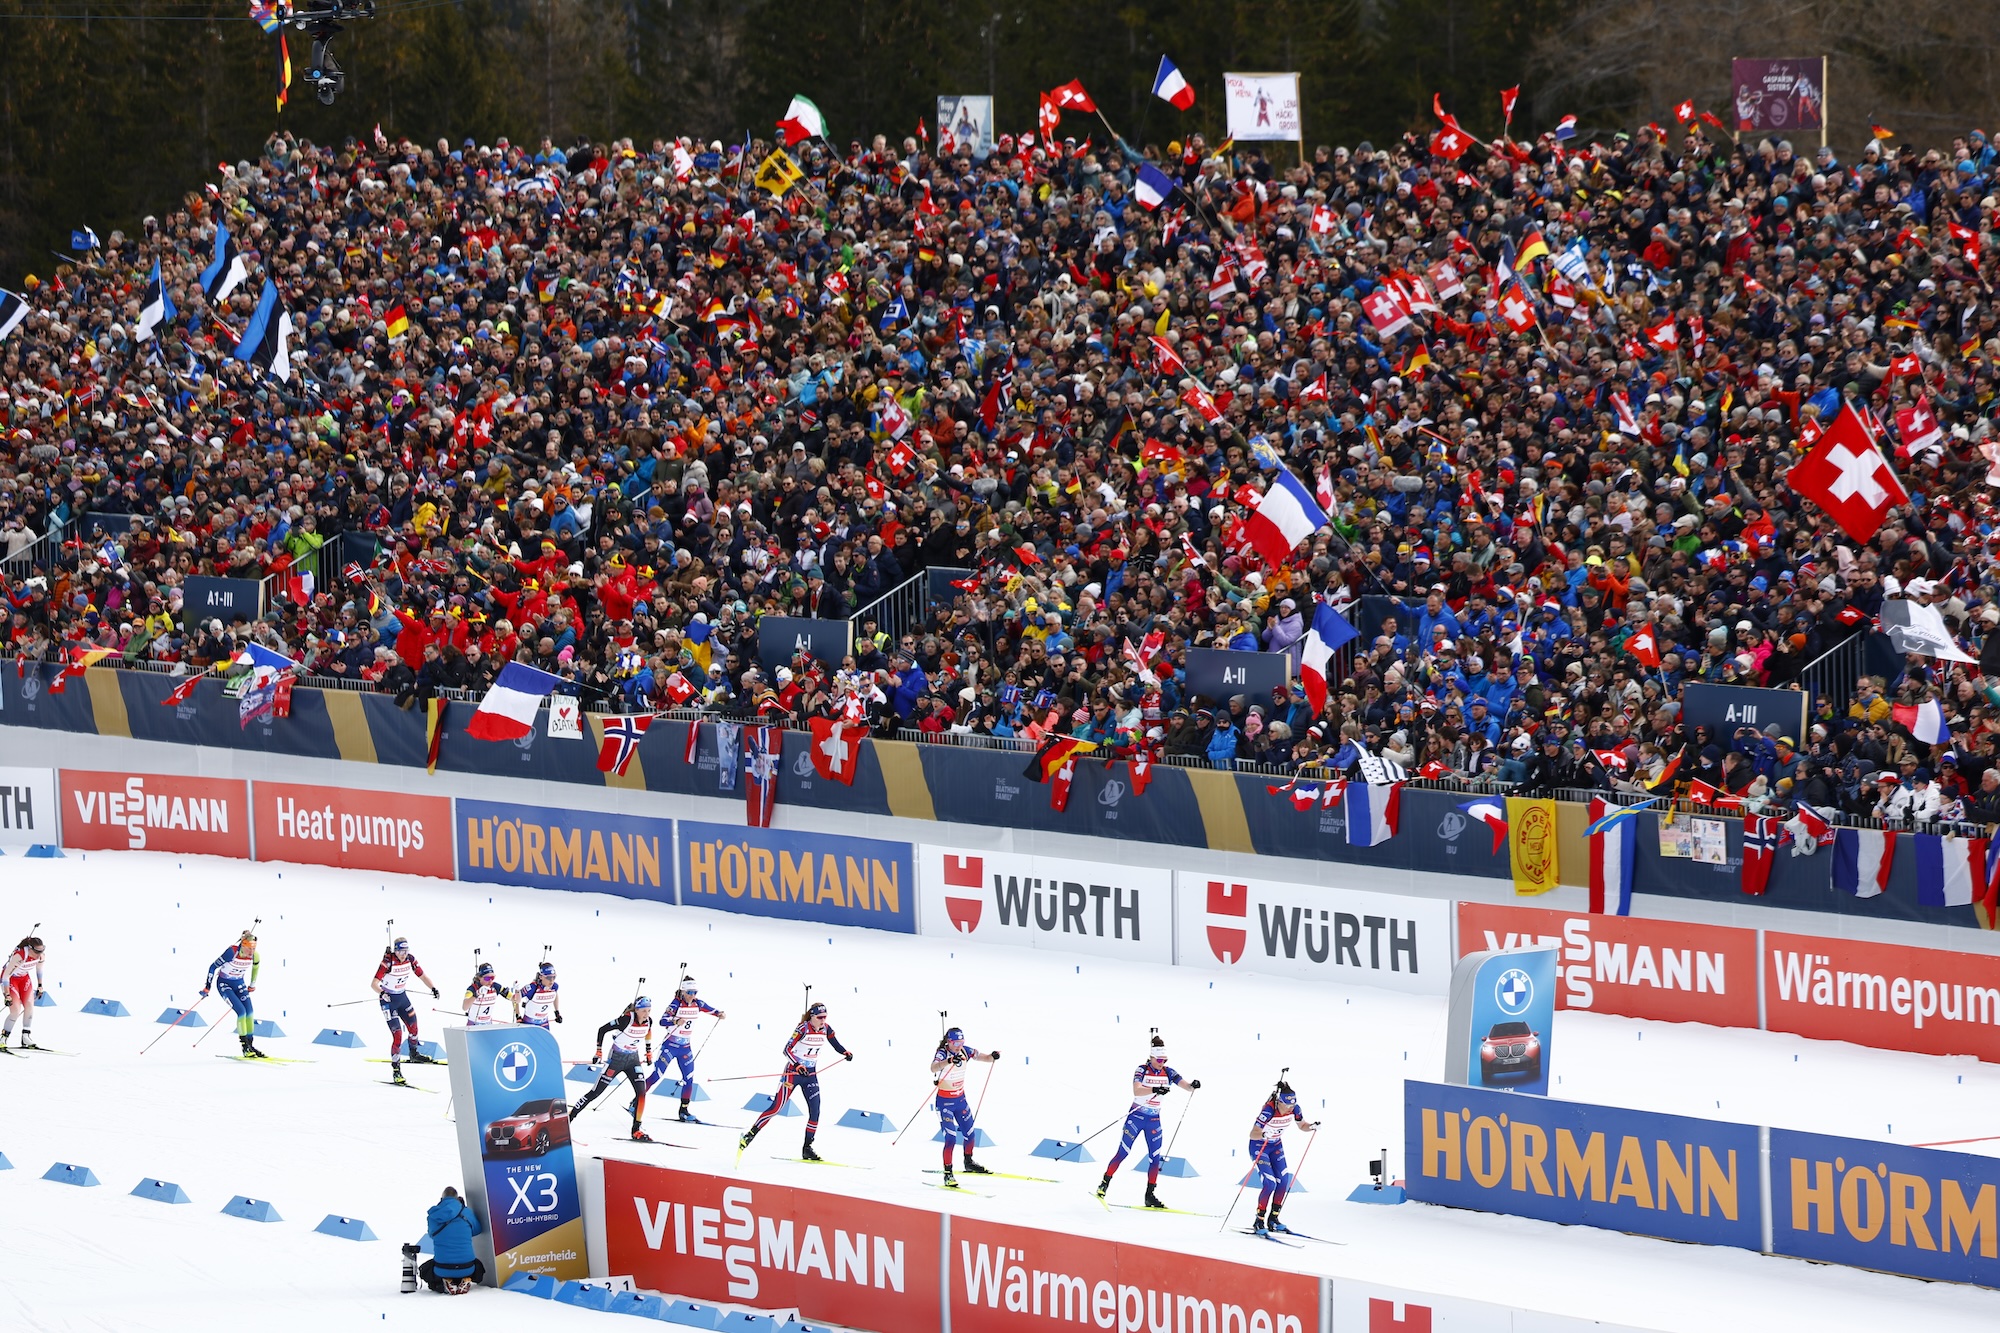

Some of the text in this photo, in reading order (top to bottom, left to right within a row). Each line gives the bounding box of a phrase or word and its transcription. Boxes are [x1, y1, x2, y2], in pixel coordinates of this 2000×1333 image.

[1763, 76, 1794, 84] GASPARIN
[206, 590, 234, 607] A1-III
[795, 633, 812, 650] A-I
[1223, 666, 1246, 685] A-II
[1725, 704, 1757, 724] A-III
[521, 753, 531, 761] IBU
[698, 755, 720, 763] BIATHLO
[698, 763, 717, 771] FAMILY
[801, 780, 812, 789] IBU
[995, 785, 1020, 794] BIATHLON
[995, 793, 1013, 801] FAMILY
[74, 777, 228, 849] VIESSMANN
[1105, 810, 1118, 820] IBU
[1320, 817, 1345, 826] BIATHLO
[277, 797, 424, 858] Heat pumps
[1319, 825, 1340, 834] FAMILY
[1521, 814, 1545, 845] MADE
[467, 815, 661, 887] HÖRMANN
[1446, 845, 1457, 854] IBU
[690, 838, 899, 913] HÖRMANN
[994, 874, 1140, 941] WÜRTH
[1258, 902, 1419, 974] WÜRTH
[483, 1006, 490, 1015] 4
[541, 1004, 548, 1013] 9
[684, 1020, 692, 1030] 8
[808, 1047, 820, 1056] 11
[525, 1164, 541, 1172] NEW
[1421, 1107, 1738, 1221] HÖRMANN
[507, 1173, 559, 1215] X3
[1790, 1156, 1998, 1259] HÖRM
[507, 1213, 559, 1225] PLUG-IN-HYBRID
[634, 1186, 905, 1300] VIESSMANN
[520, 1249, 576, 1265] Lenzerheide
[623, 1280, 629, 1291] 1
